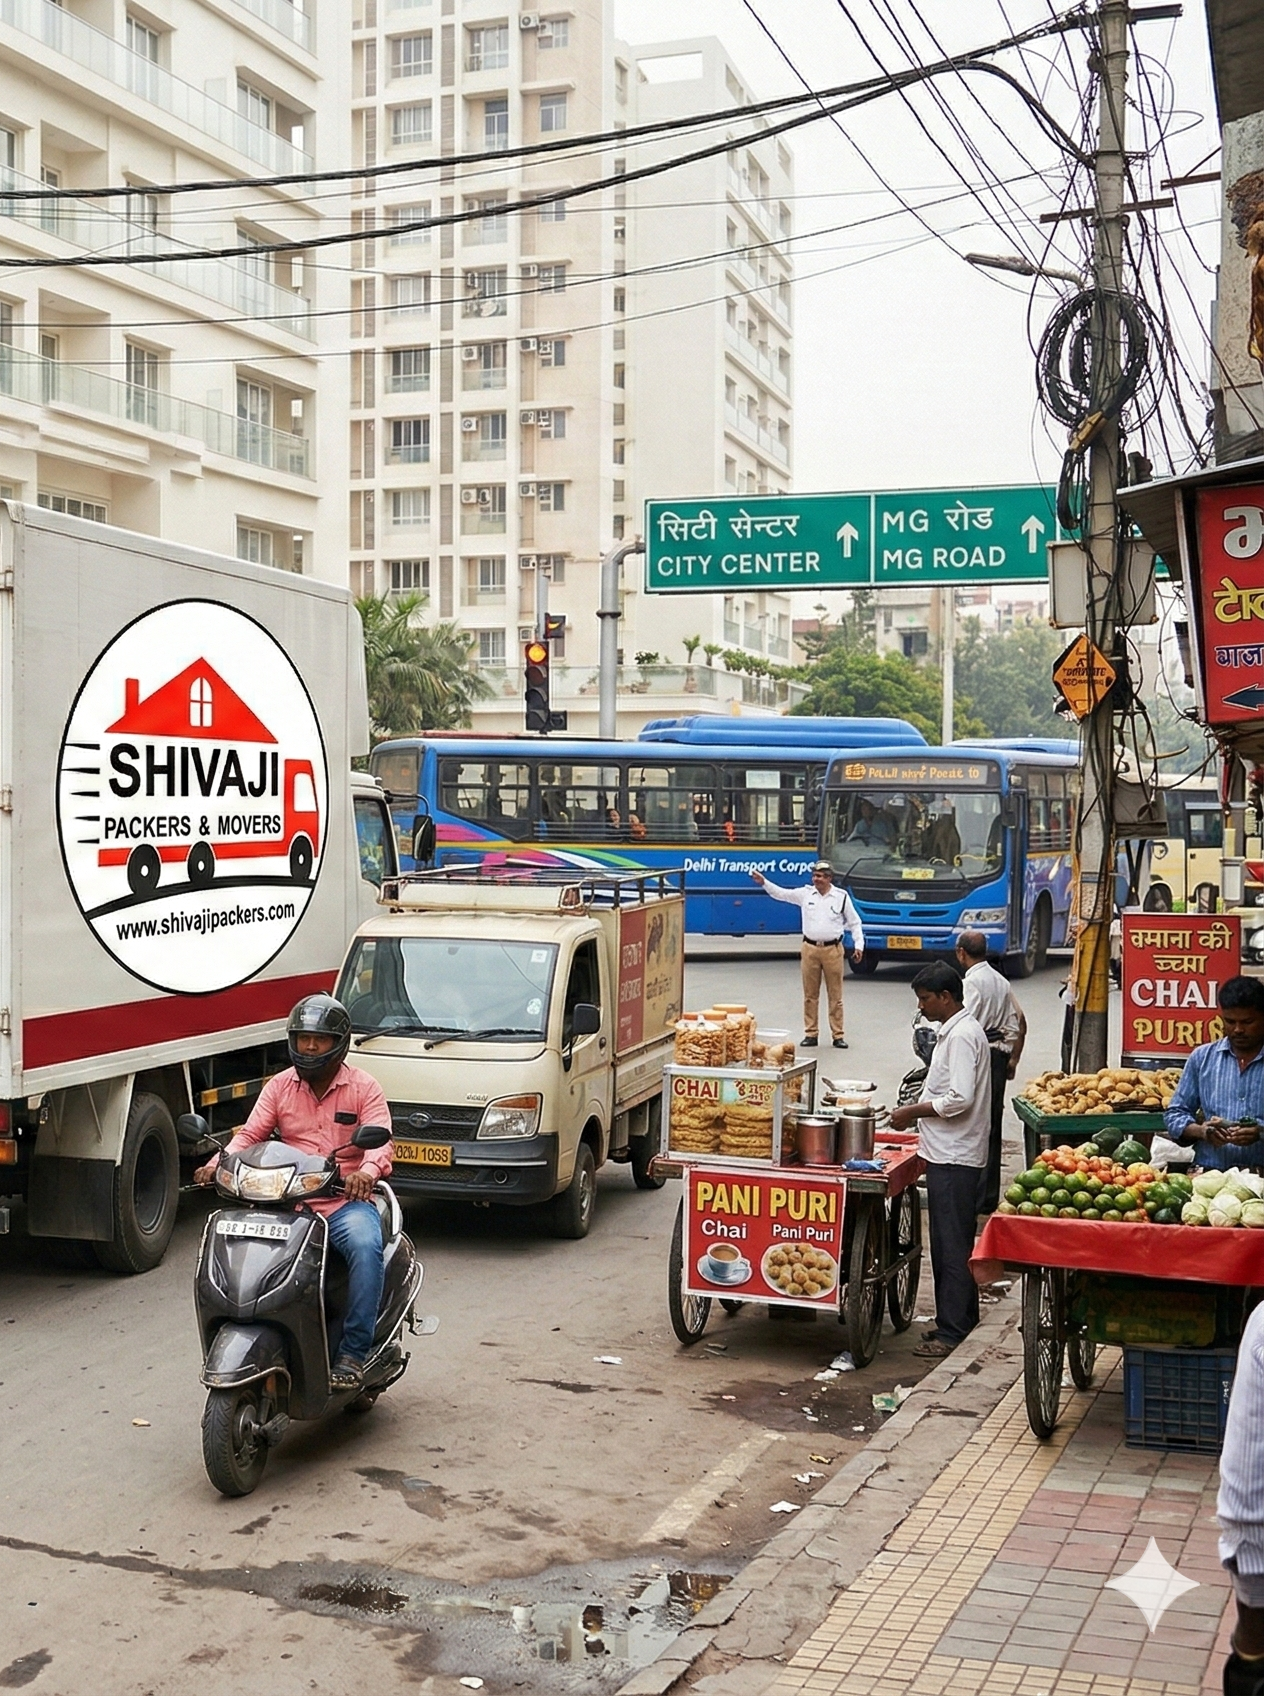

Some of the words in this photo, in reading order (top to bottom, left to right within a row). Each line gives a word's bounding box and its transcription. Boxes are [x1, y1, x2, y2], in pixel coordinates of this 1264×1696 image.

[657, 509, 718, 542] सिटी
[728, 508, 800, 539] सेन्टर
[882, 509, 929, 534] MG
[943, 500, 995, 532] रोड
[657, 554, 713, 577] CITY
[720, 551, 821, 575] CENTER
[882, 548, 923, 570] MG
[933, 546, 1006, 568] ROAD
[109, 743, 279, 797] SHIVAJI
[105, 815, 191, 839] PACKERS
[199, 815, 210, 836] &
[218, 815, 281, 835] MOVERS
[684, 857, 717, 872] Delhi
[718, 858, 776, 876] Transport
[116, 903, 295, 940] www.shivajipackers.com
[1130, 979, 1218, 1009] CHAI
[1132, 1017, 1204, 1048] PURI
[674, 1078, 718, 1098] CHAI
[696, 1181, 760, 1217] PANI
[769, 1187, 836, 1224] PURI
[701, 1219, 747, 1239] Chai
[772, 1224, 802, 1239] Pani
